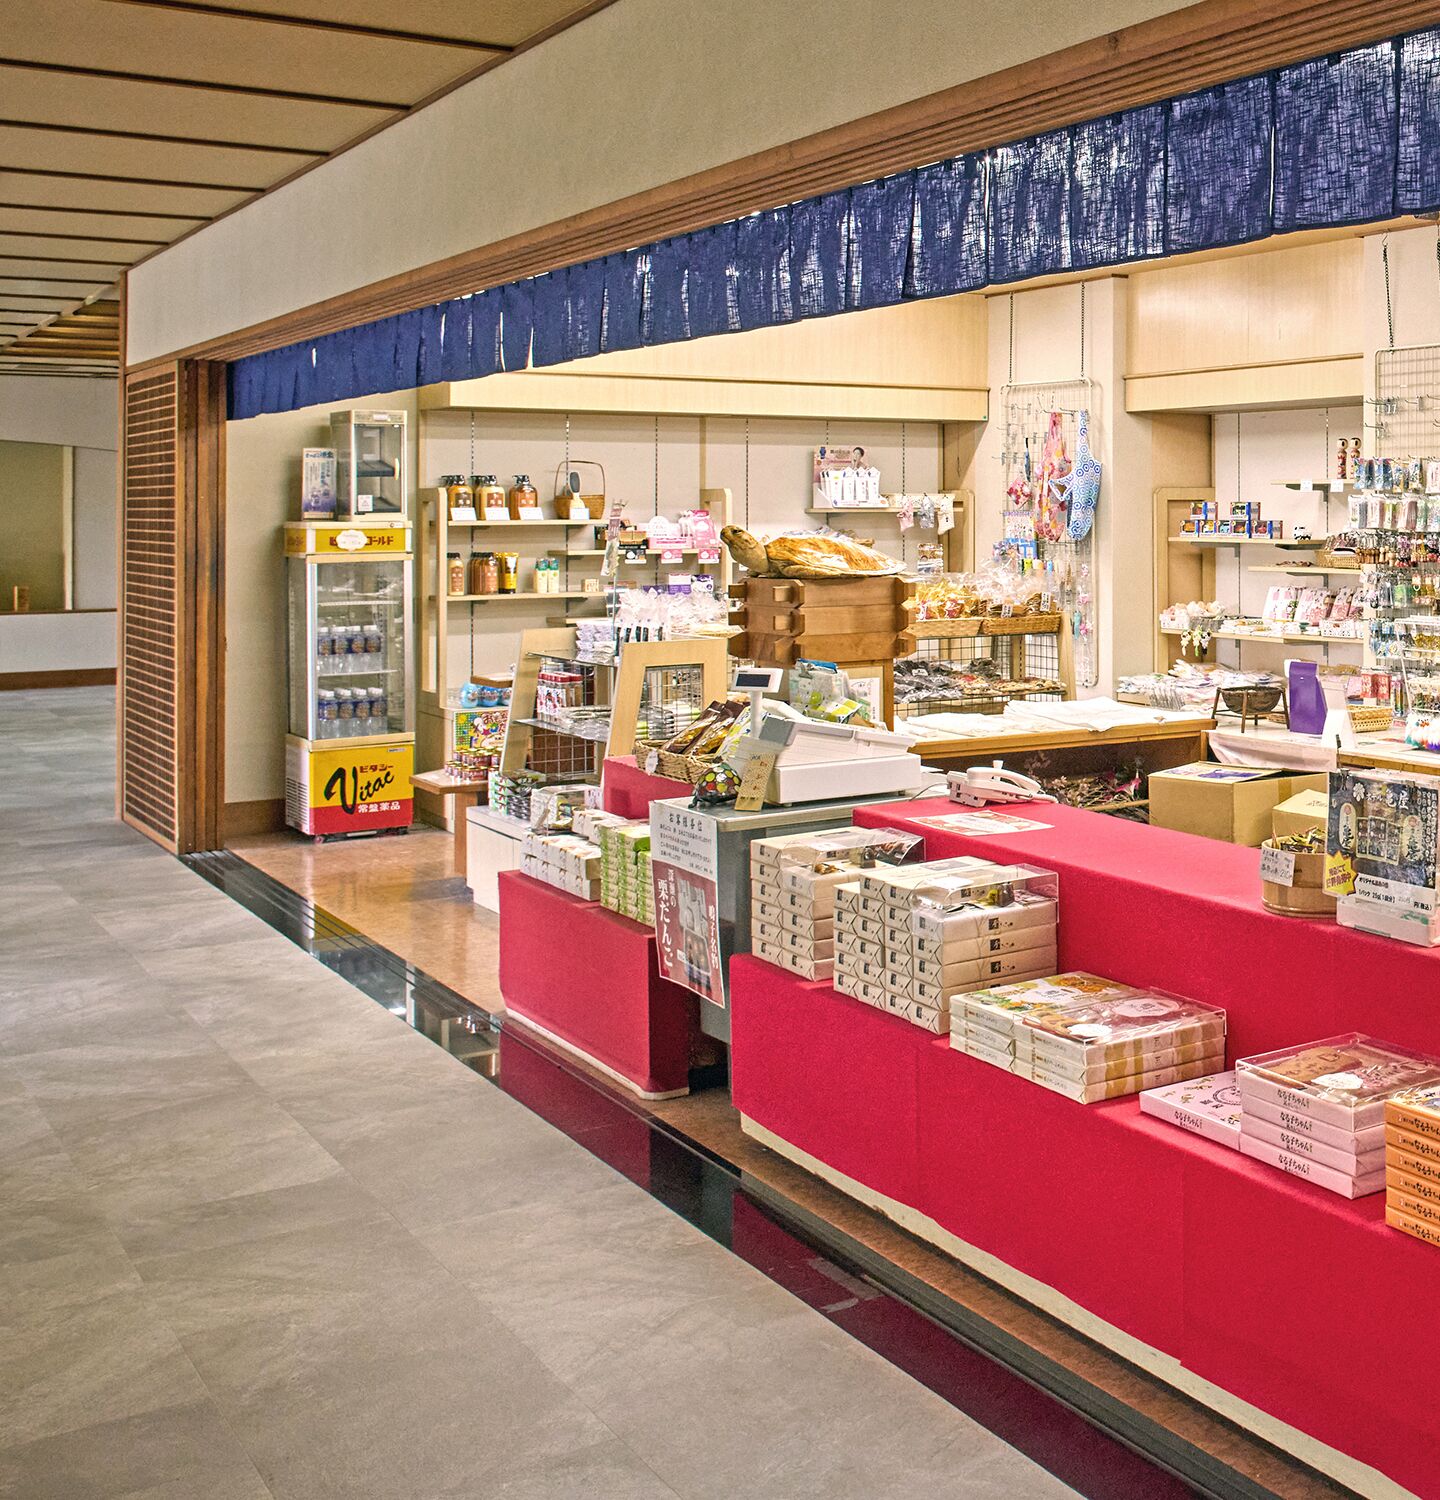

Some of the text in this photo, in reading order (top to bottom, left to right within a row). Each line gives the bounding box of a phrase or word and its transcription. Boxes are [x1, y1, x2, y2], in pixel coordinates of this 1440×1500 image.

[329, 536, 394, 546] ビゴールド
[360, 763, 394, 773] ビタシー
[324, 766, 394, 815] Vitac
[358, 801, 401, 814] 常盤薬品
[657, 878, 674, 969] 栗だんご
